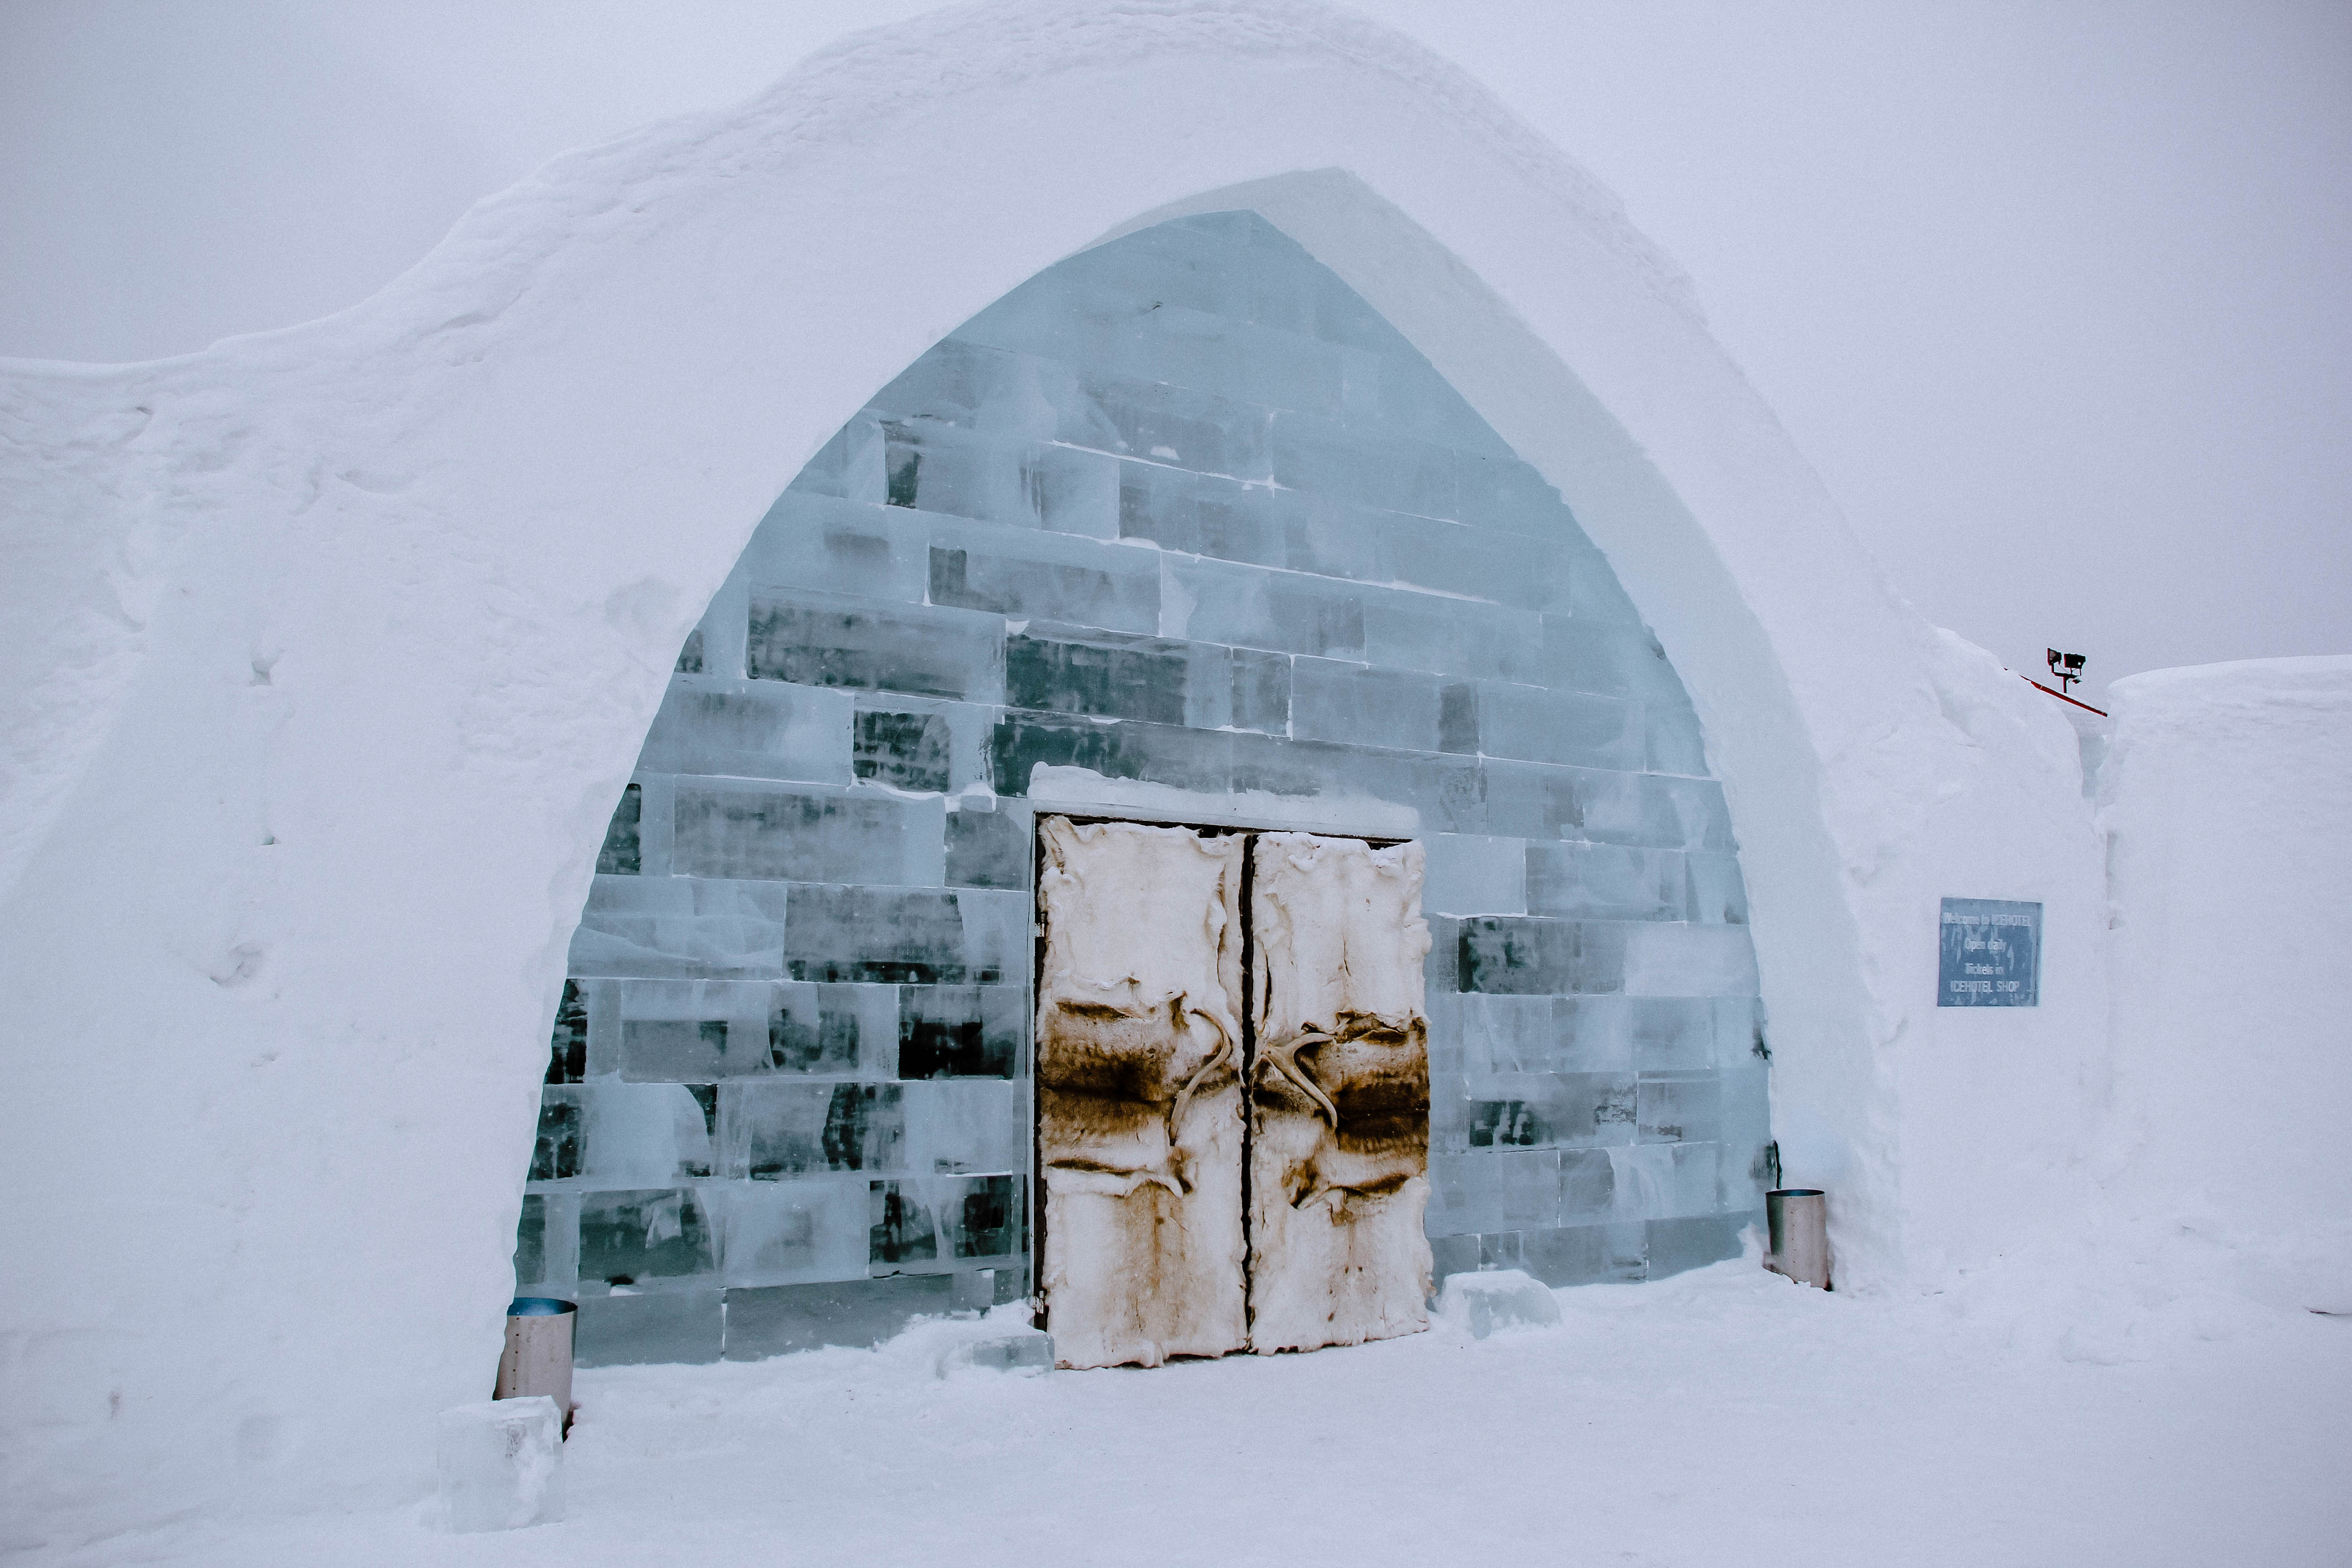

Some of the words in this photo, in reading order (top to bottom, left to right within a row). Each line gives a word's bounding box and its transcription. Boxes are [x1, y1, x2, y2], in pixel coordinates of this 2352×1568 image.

[1981, 915, 1990, 925] to
[1991, 914, 2030, 926] ICEHOTEL
[1965, 937, 1986, 951] Open
[1988, 938, 2007, 952] daily
[1965, 963, 1994, 975] Tickets
[1995, 963, 2004, 975] in
[1950, 980, 1993, 993] ICEHOTEL
[1996, 980, 2020, 992] SHOP
